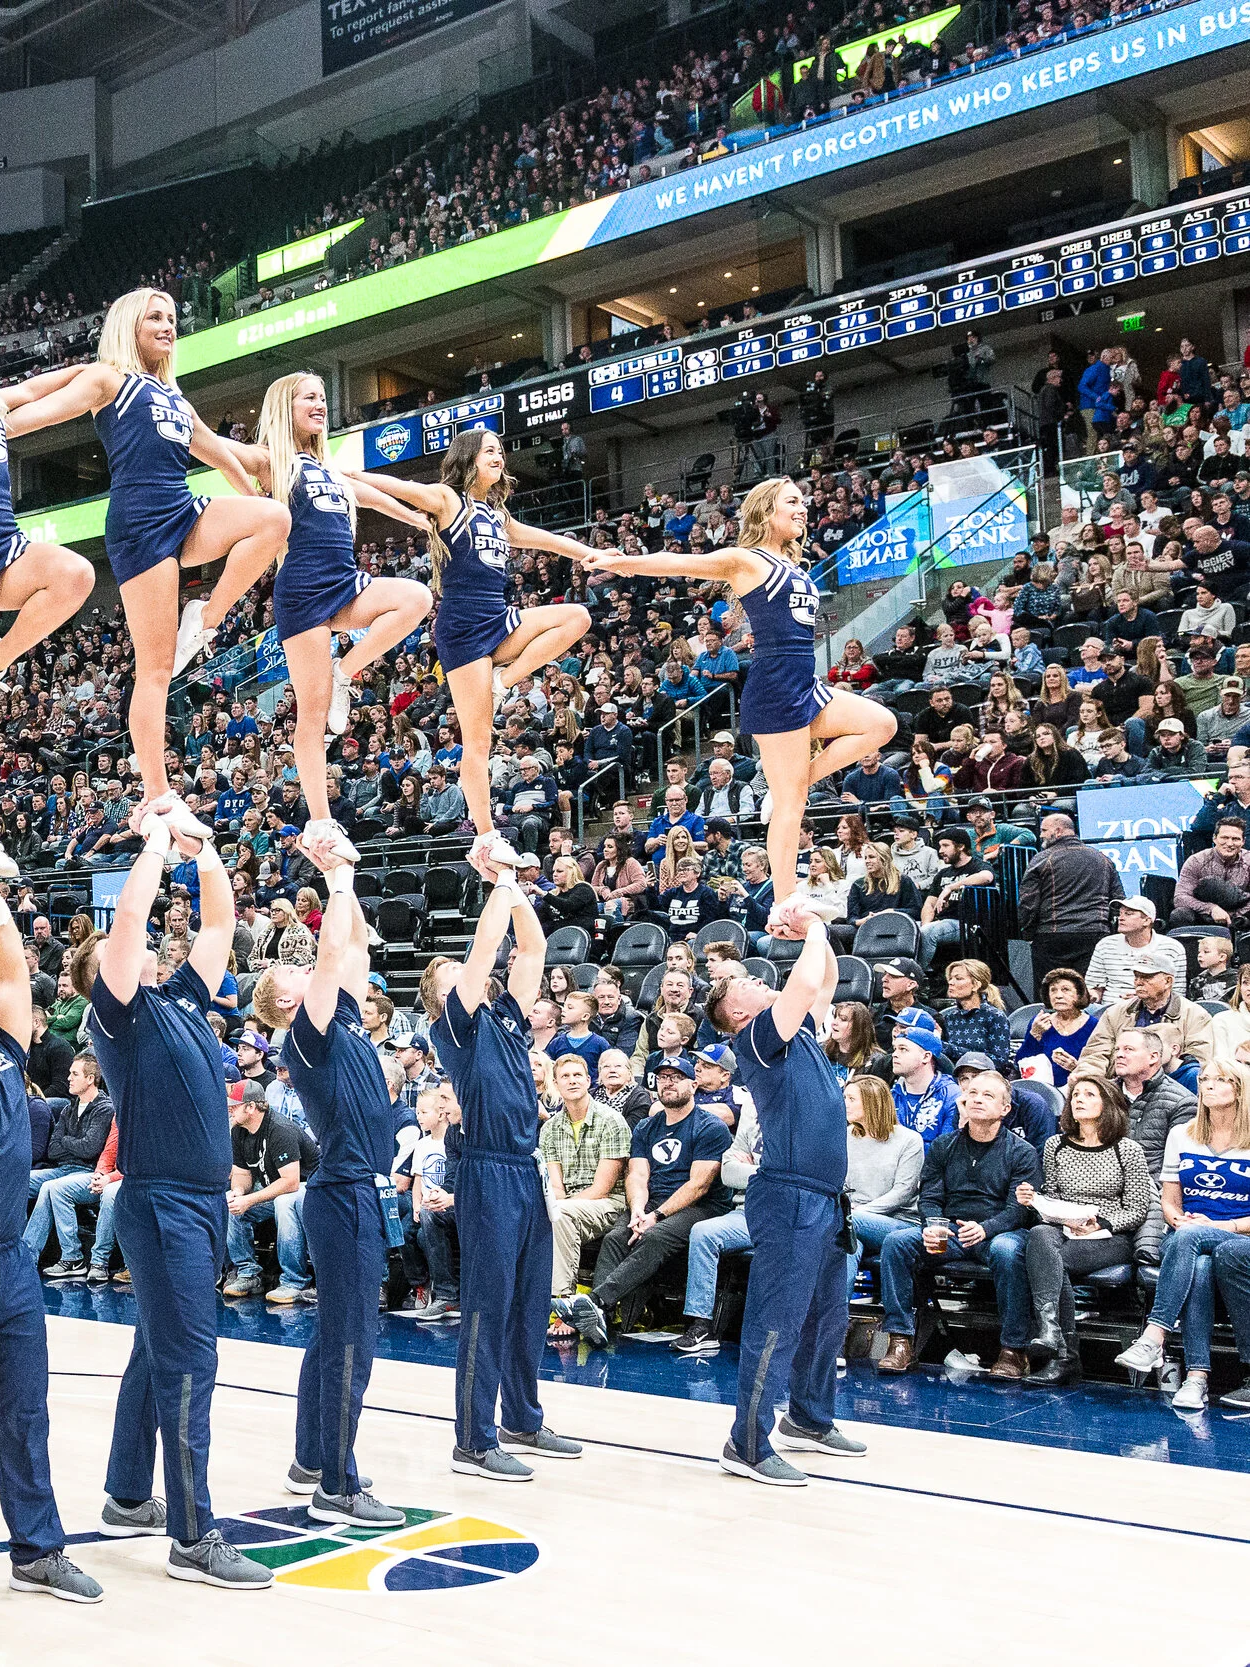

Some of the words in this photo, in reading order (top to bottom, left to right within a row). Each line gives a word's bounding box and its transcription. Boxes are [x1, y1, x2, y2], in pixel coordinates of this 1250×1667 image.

[327, 0, 376, 21] TEX
[330, 26, 344, 39] To
[347, 8, 384, 32] report
[353, 29, 366, 43] or
[369, 9, 415, 38] request
[417, 0, 450, 16] assis
[655, 186, 686, 210] WE
[694, 153, 784, 200] HAVEN'T
[793, 104, 939, 167] FORGOTTEN
[949, 81, 1012, 116] WHO
[1021, 51, 1101, 93] KEEPS
[1110, 37, 1146, 64] US
[1157, 24, 1187, 50] IN
[1194, 226, 1205, 239] 1
[738, 328, 754, 341] FG
[784, 313, 812, 329] FG%
[839, 299, 866, 315] 3PT
[889, 284, 928, 301] 3PT%
[958, 269, 976, 284] FT
[1011, 253, 1045, 270] FT%
[1061, 239, 1093, 256] OREB
[1100, 229, 1133, 246] DREB
[1141, 219, 1172, 235] REB
[1182, 208, 1215, 225] AST
[1017, 288, 1044, 304] 100
[1069, 301, 1084, 316] V
[518, 382, 574, 413] 15:56
[610, 385, 625, 402] 4
[527, 413, 542, 428] 1ST
[544, 408, 568, 423] HALF
[946, 505, 1016, 534] ZIONS
[947, 525, 1021, 552] BANK
[224, 799, 245, 808] BYU
[1097, 815, 1195, 842] ZION
[1100, 844, 1178, 873] BAN
[668, 907, 700, 917] STATE
[1179, 1158, 1250, 1178] BYU
[1183, 1187, 1249, 1202] cougars
